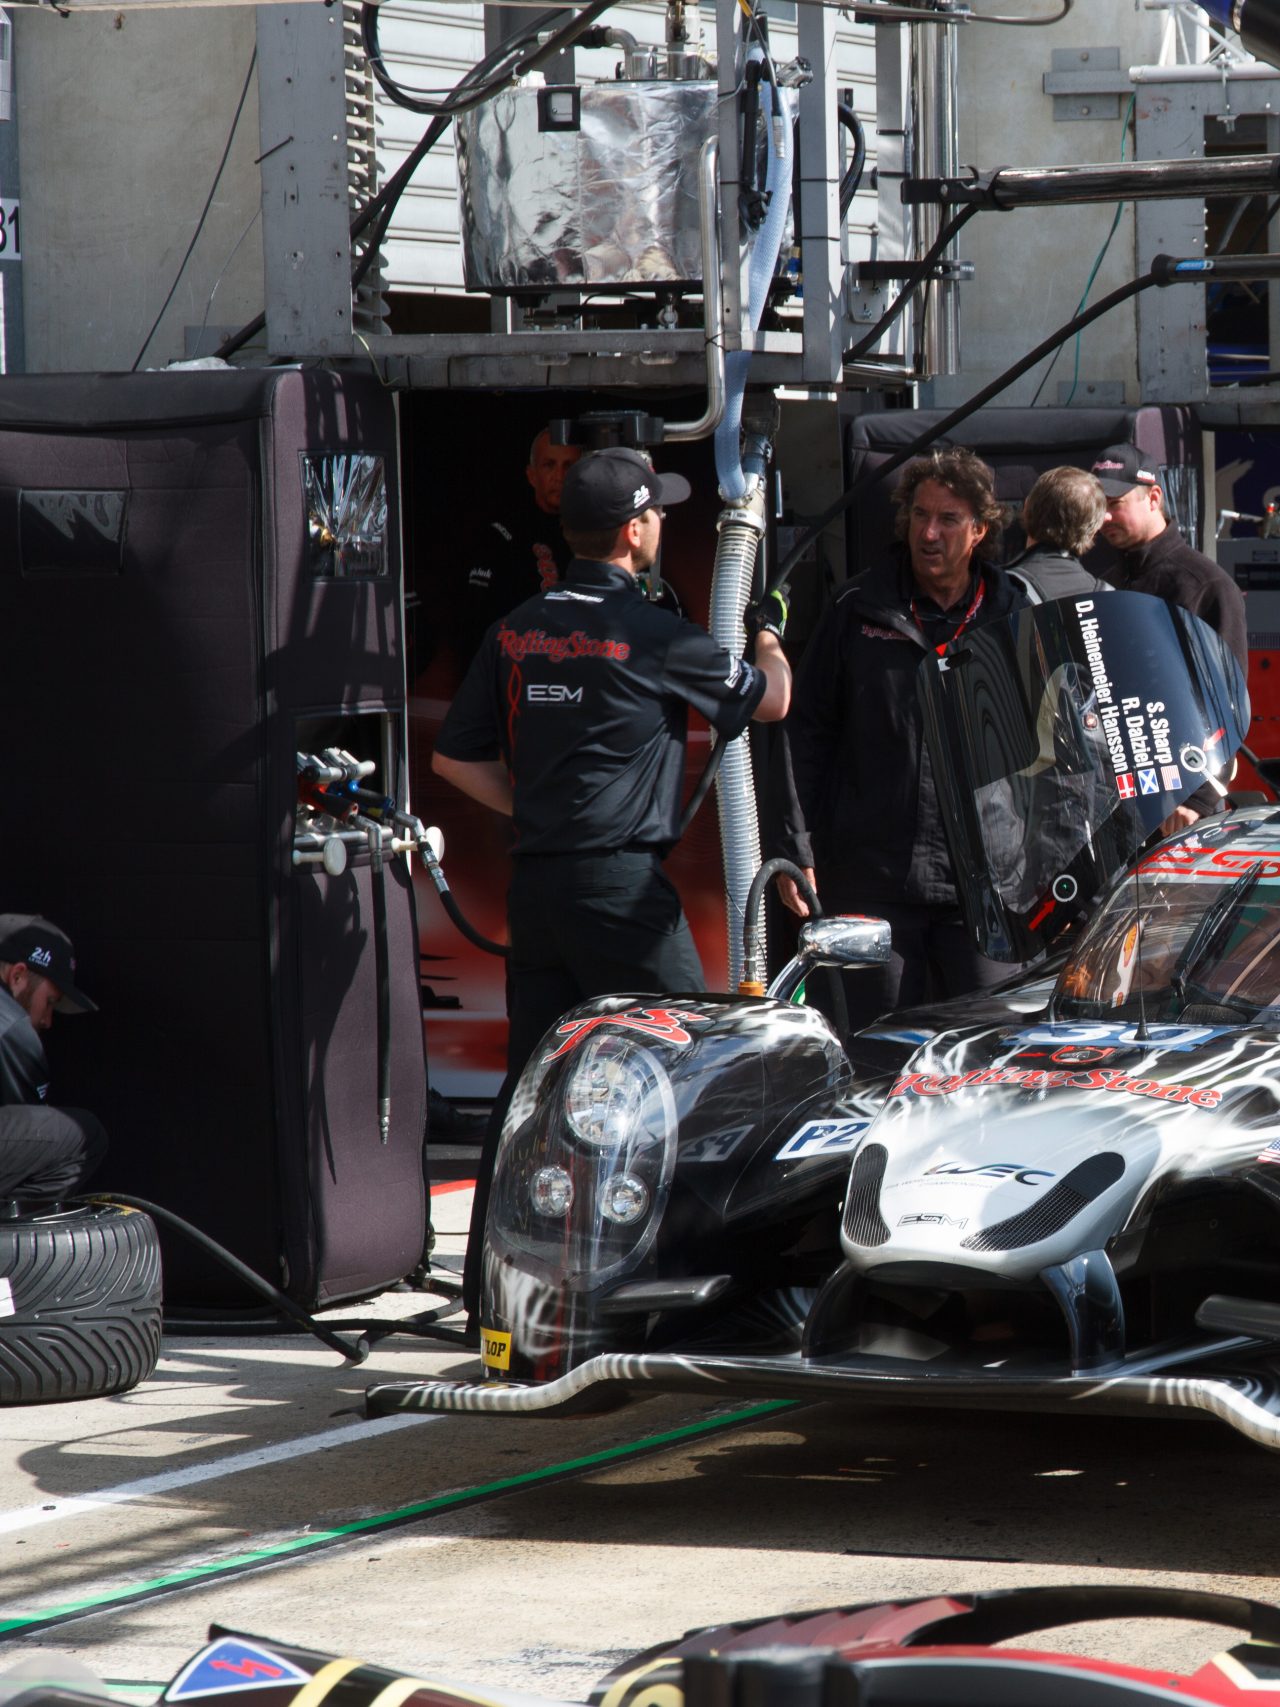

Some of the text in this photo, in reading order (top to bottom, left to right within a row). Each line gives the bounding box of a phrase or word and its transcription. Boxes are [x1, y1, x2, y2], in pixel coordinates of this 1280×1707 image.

[527, 685, 583, 702] ESM
[1075, 600, 1129, 773] D. Heinemeier Hansson
[1121, 696, 1154, 768] R. Dalziel
[1146, 701, 1173, 764] S. Sharp
[1028, 1024, 1213, 1046] 30
[787, 1121, 872, 1153] P2
[922, 1160, 1057, 1187] WEC
